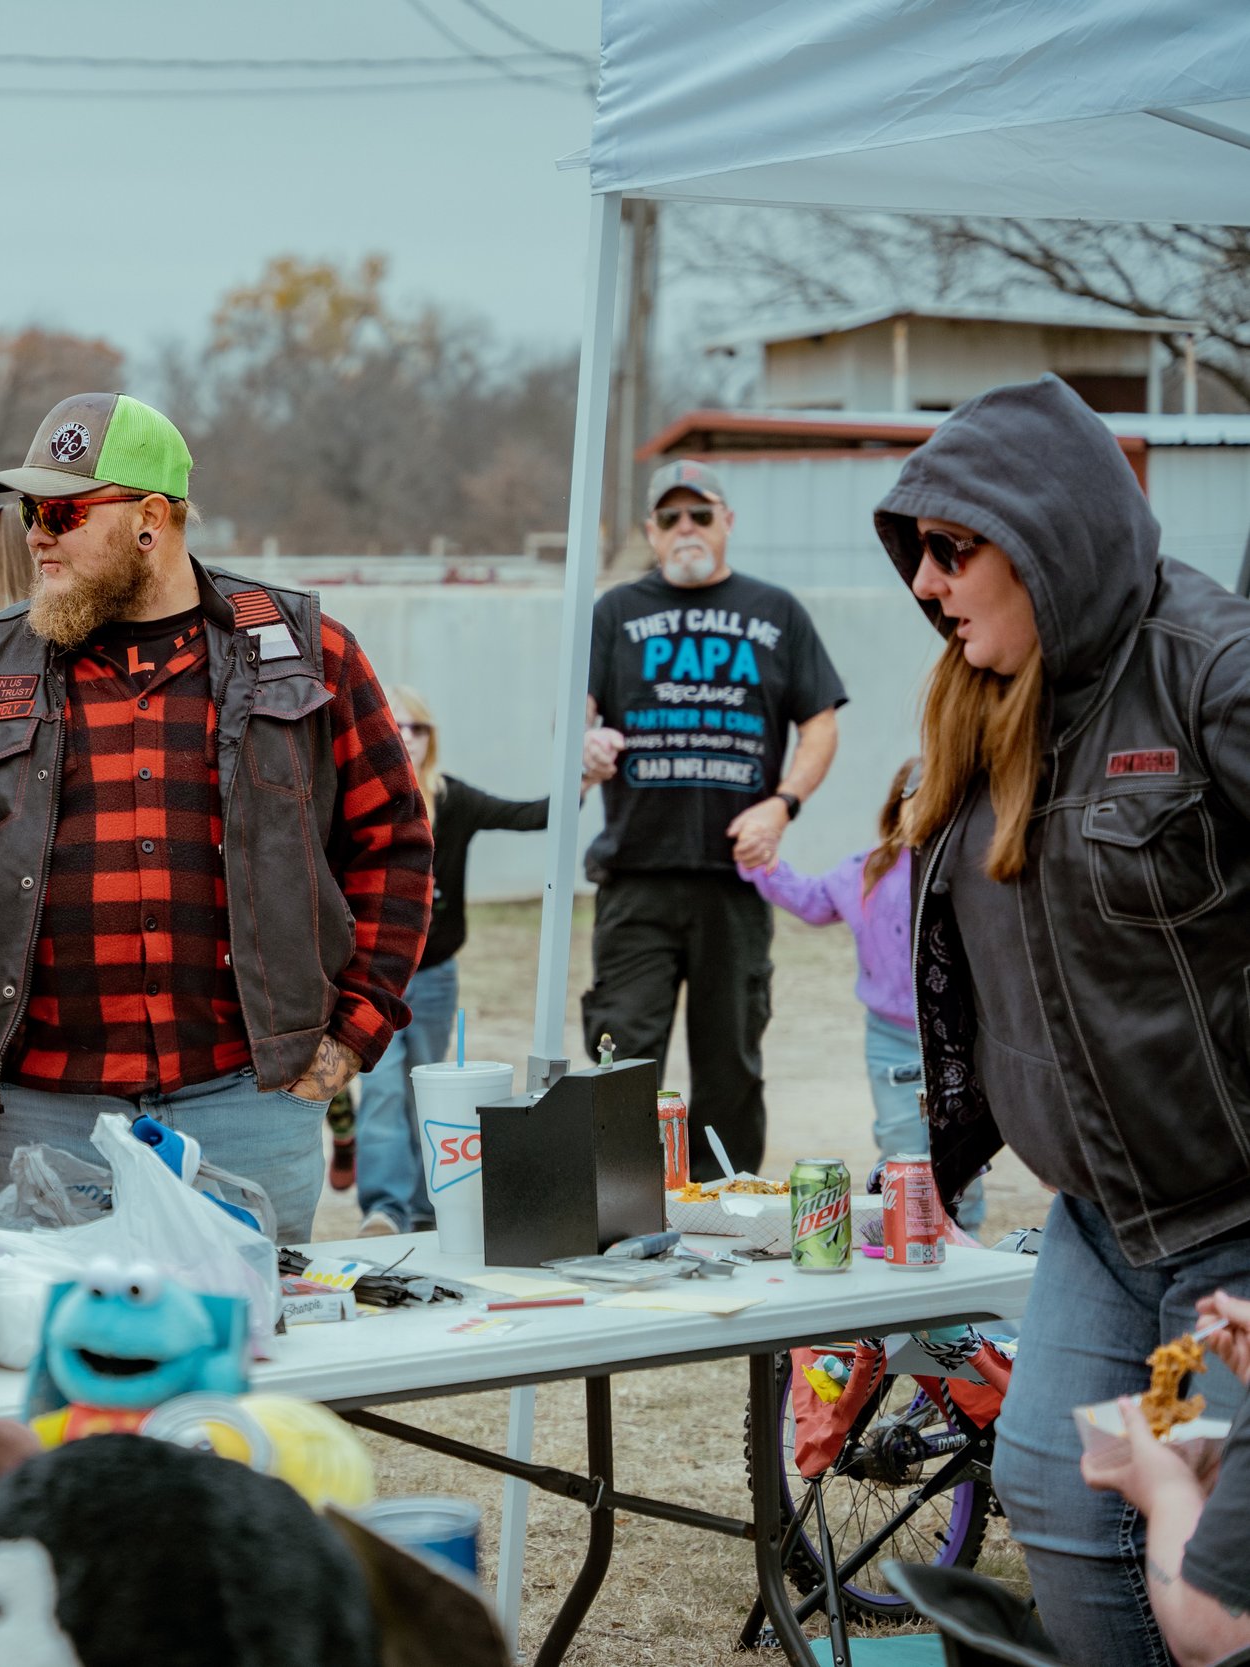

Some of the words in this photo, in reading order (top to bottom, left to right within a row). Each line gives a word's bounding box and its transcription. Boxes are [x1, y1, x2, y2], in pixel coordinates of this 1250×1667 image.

[623, 608, 682, 643] THEY
[685, 608, 744, 636] CALL
[746, 617, 782, 650] ME
[642, 635, 761, 686] PAPA
[1, 687, 31, 697] TRUST
[10, 679, 23, 687] US
[653, 681, 748, 706] BECAUSE
[624, 708, 700, 730] PARTNER
[637, 758, 671, 780] BAD
[673, 757, 753, 785] INFLUENCE
